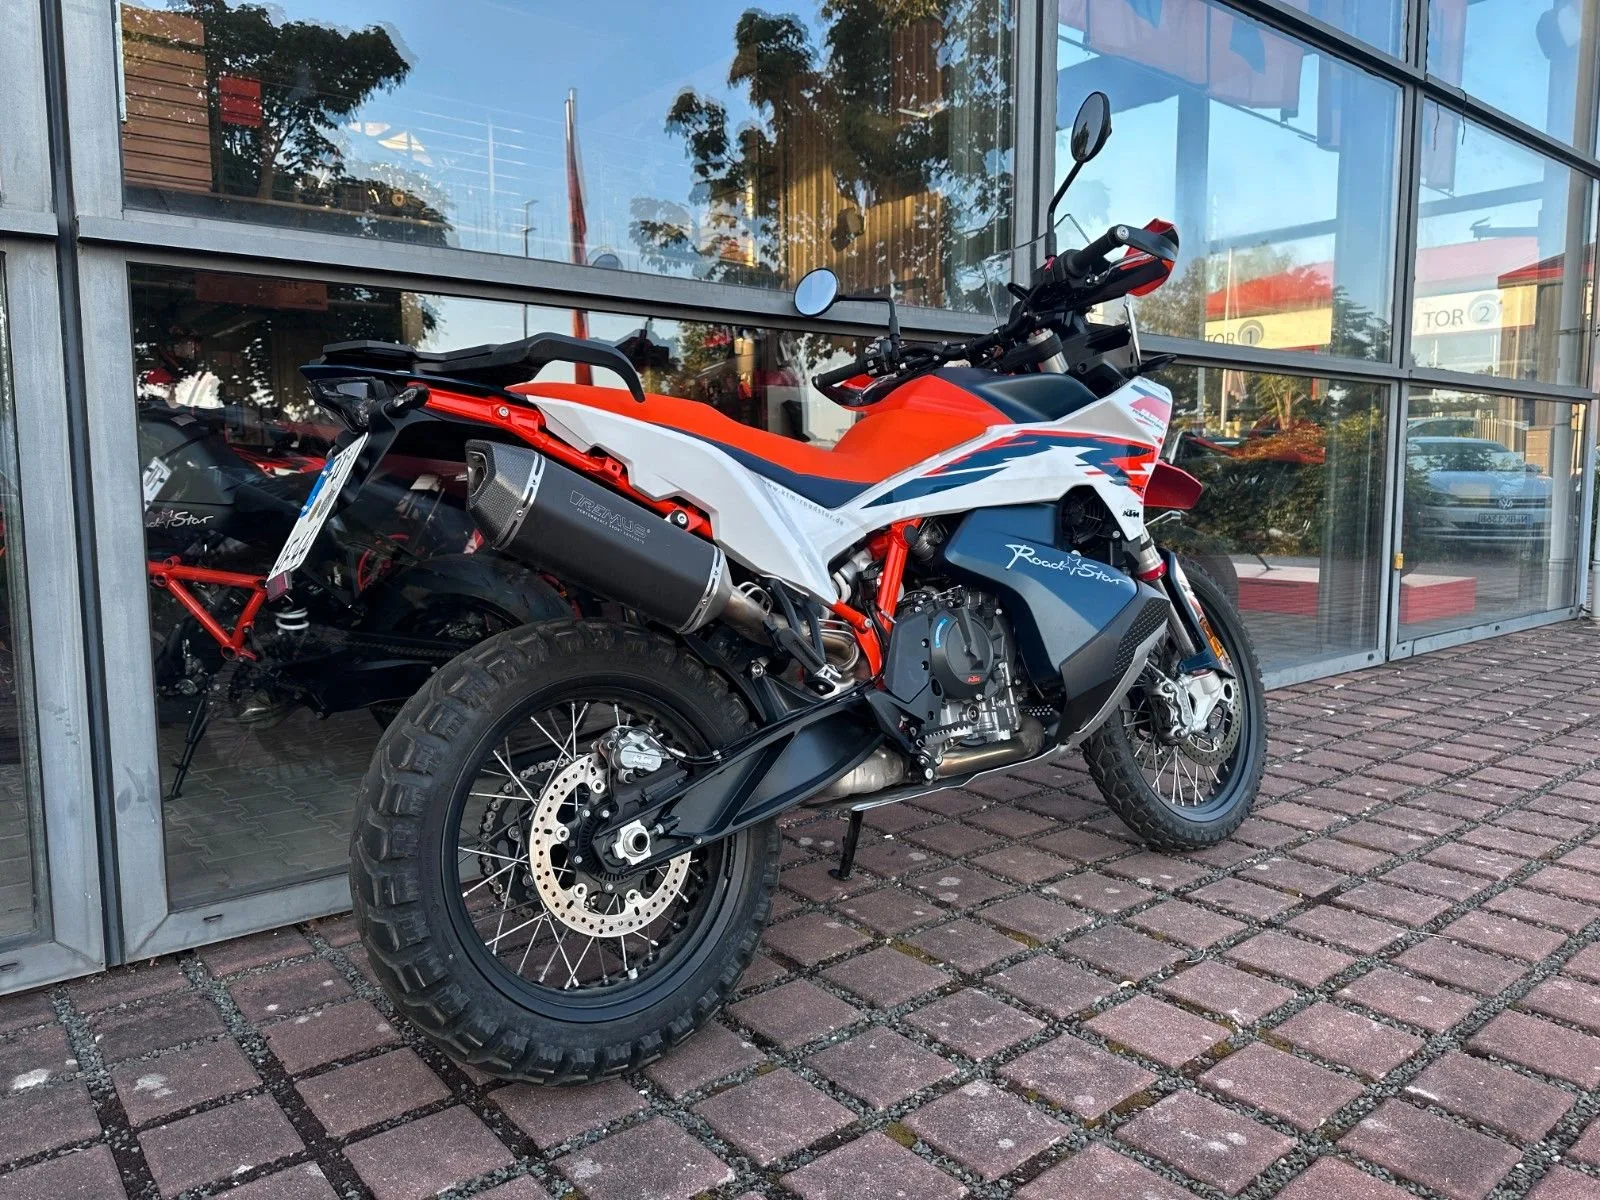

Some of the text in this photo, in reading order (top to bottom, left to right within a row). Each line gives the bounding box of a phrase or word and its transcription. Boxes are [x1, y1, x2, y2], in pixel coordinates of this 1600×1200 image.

[1422, 308, 1465, 329] TOR
[1205, 332, 1235, 345] TOR
[171, 511, 215, 528] Star
[578, 496, 648, 539] REMUS
[1122, 509, 1140, 518] KTM
[1004, 544, 1130, 585] Road Star
